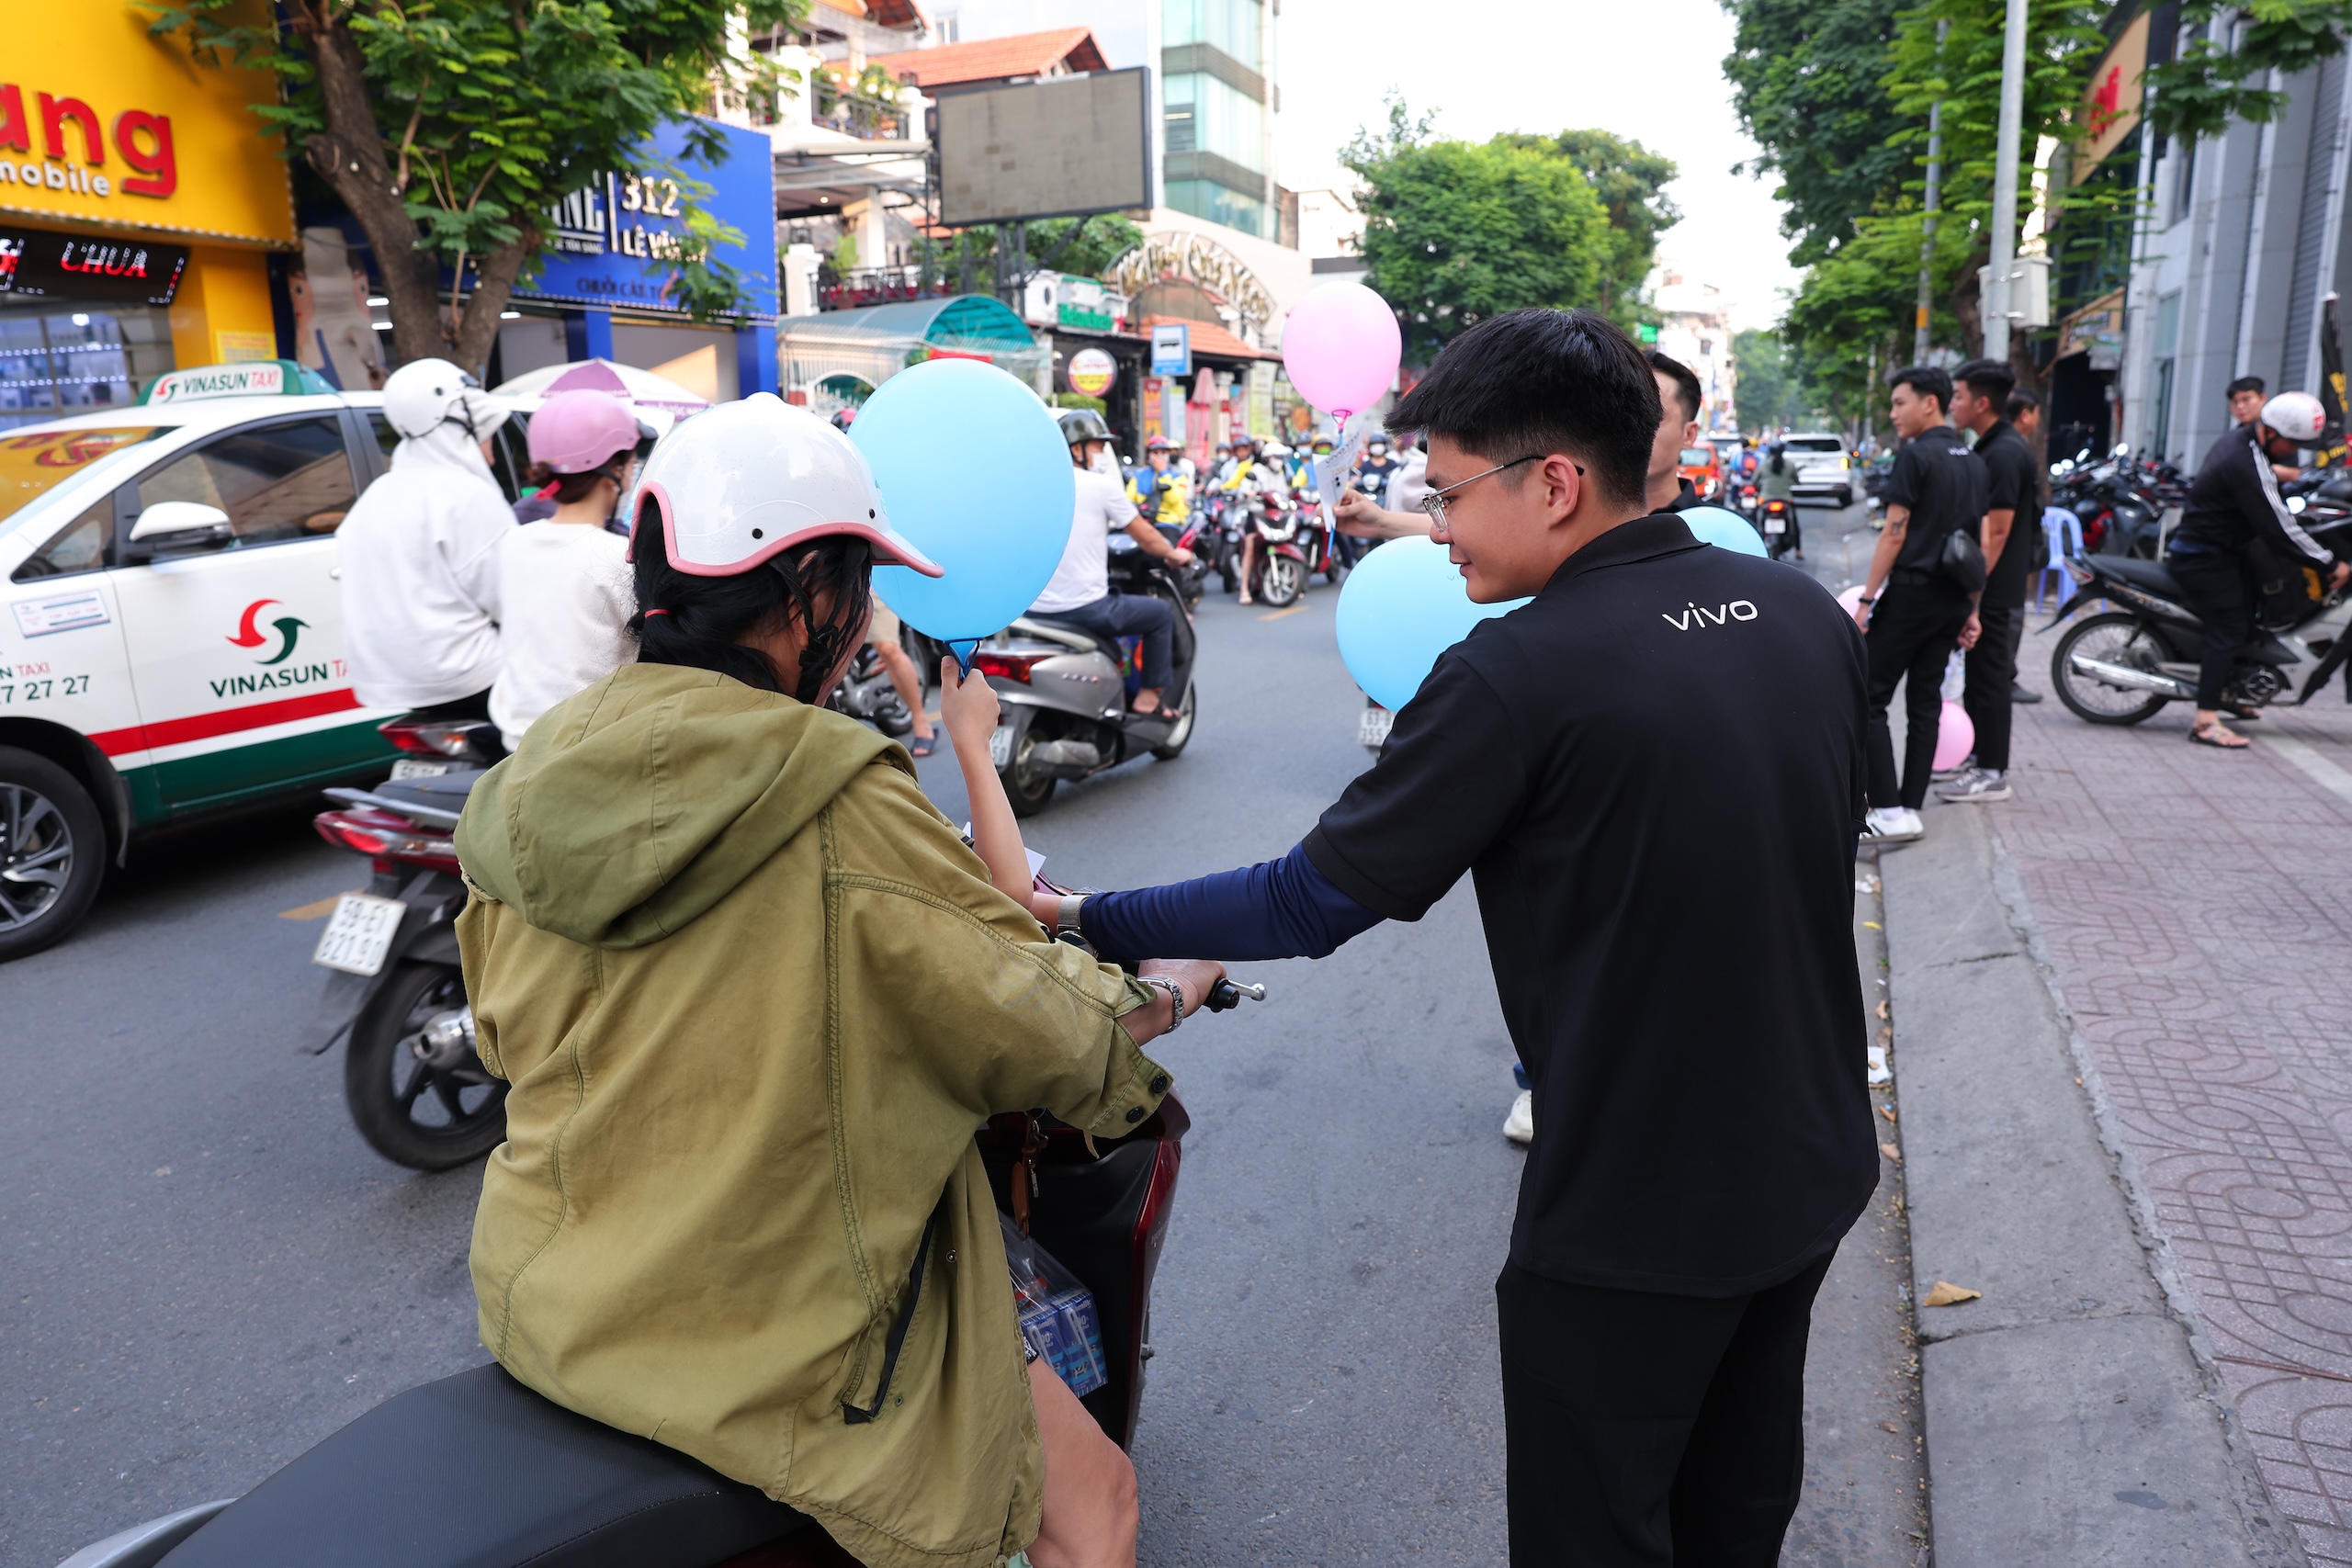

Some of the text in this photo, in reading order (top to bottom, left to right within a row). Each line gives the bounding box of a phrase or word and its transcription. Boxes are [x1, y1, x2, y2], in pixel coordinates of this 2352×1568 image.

[621, 172, 680, 217] 312
[623, 224, 648, 257] LÊ
[184, 370, 278, 394] VINASUN TAXI
[1661, 600, 1758, 631] vivo
[0, 661, 51, 679] N TAXI
[209, 662, 328, 698] VINASUN
[0, 674, 90, 705] 7 27 27
